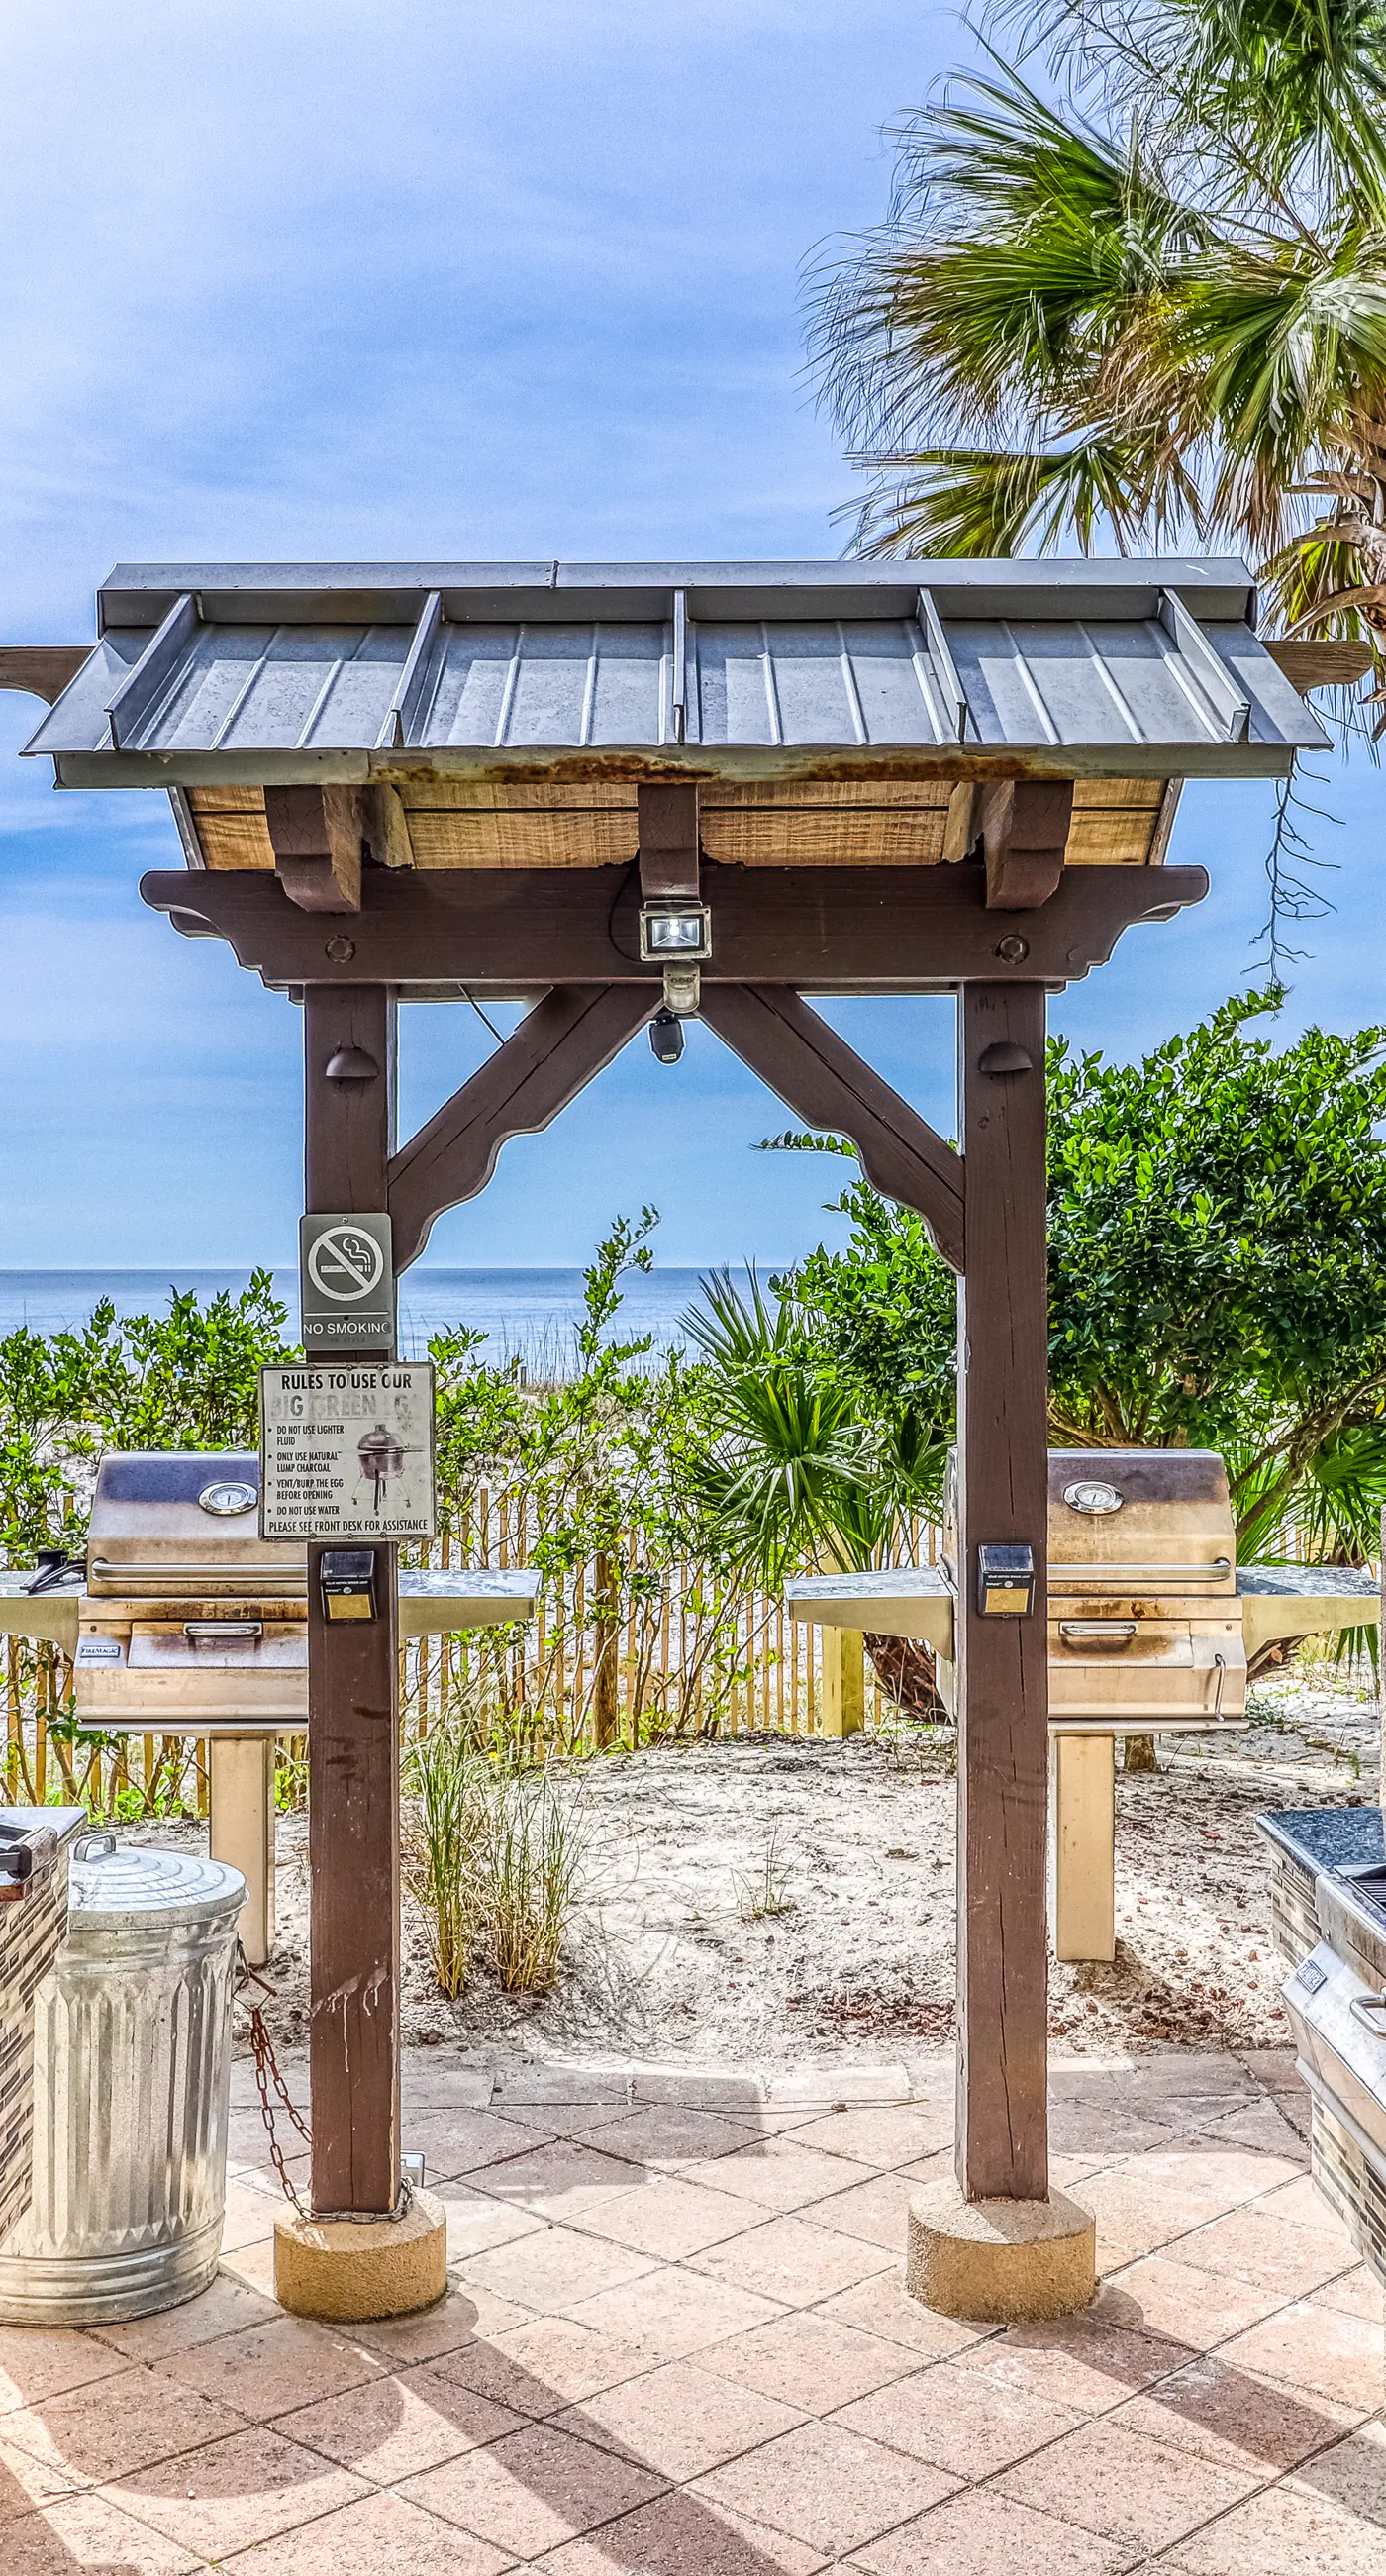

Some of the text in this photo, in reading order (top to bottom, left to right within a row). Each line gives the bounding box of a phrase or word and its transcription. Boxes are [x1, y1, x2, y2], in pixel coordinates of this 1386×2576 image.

[304, 1323, 324, 1335] NO
[281, 1374, 323, 1389] RULES
[328, 1374, 346, 1389] TO
[351, 1374, 376, 1389] USE
[277, 1425, 345, 1435] DO NOT USE LIGHTER
[277, 1437, 295, 1445] FLUID
[277, 1451, 293, 1461] ONLY
[295, 1451, 307, 1461] USE
[277, 1463, 331, 1472] LUMP CHARCOAL
[276, 1478, 344, 1489] VENT/BURP THE EGG
[277, 1490, 333, 1500] BEFORE OPENING
[277, 1505, 340, 1515] DO NOT USE WATER
[269, 1519, 428, 1532] PLEASE SEE FRONT DESK FOR ASSISTANCE
